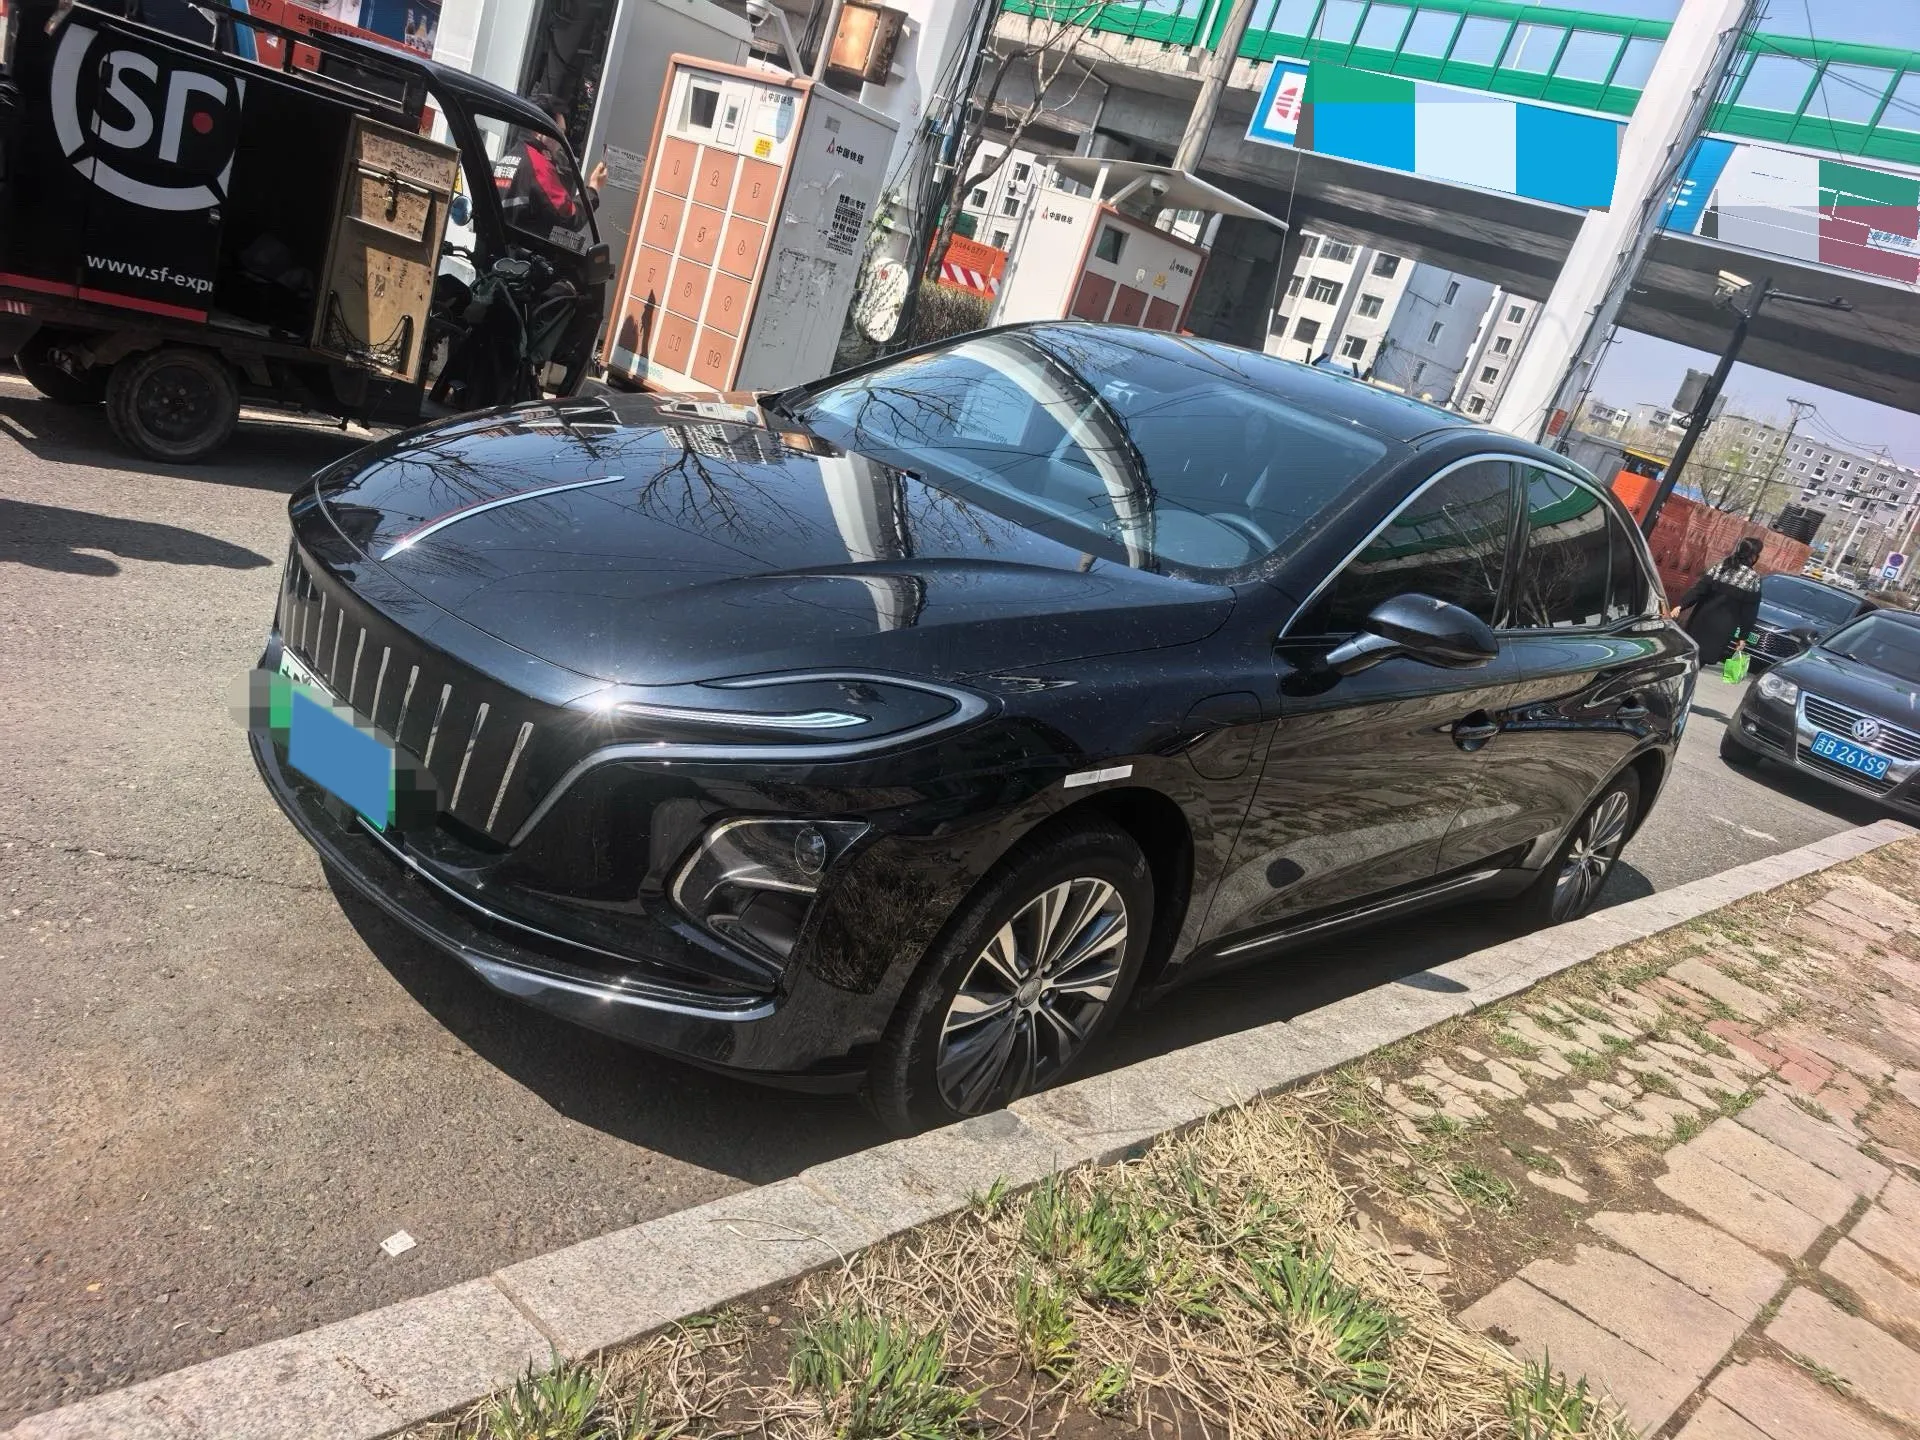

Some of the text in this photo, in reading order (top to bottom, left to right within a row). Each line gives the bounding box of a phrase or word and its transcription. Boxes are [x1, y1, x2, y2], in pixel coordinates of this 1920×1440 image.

[711, 170, 720, 187] 2
[659, 214, 668, 229] 4
[696, 227, 707, 242] 5
[1869, 231, 1912, 248] 服务热线
[737, 239, 746, 255] 6
[647, 267, 656, 283] 7
[683, 281, 693, 297] 8
[723, 296, 732, 311] 9
[707, 350, 722, 369] 12
